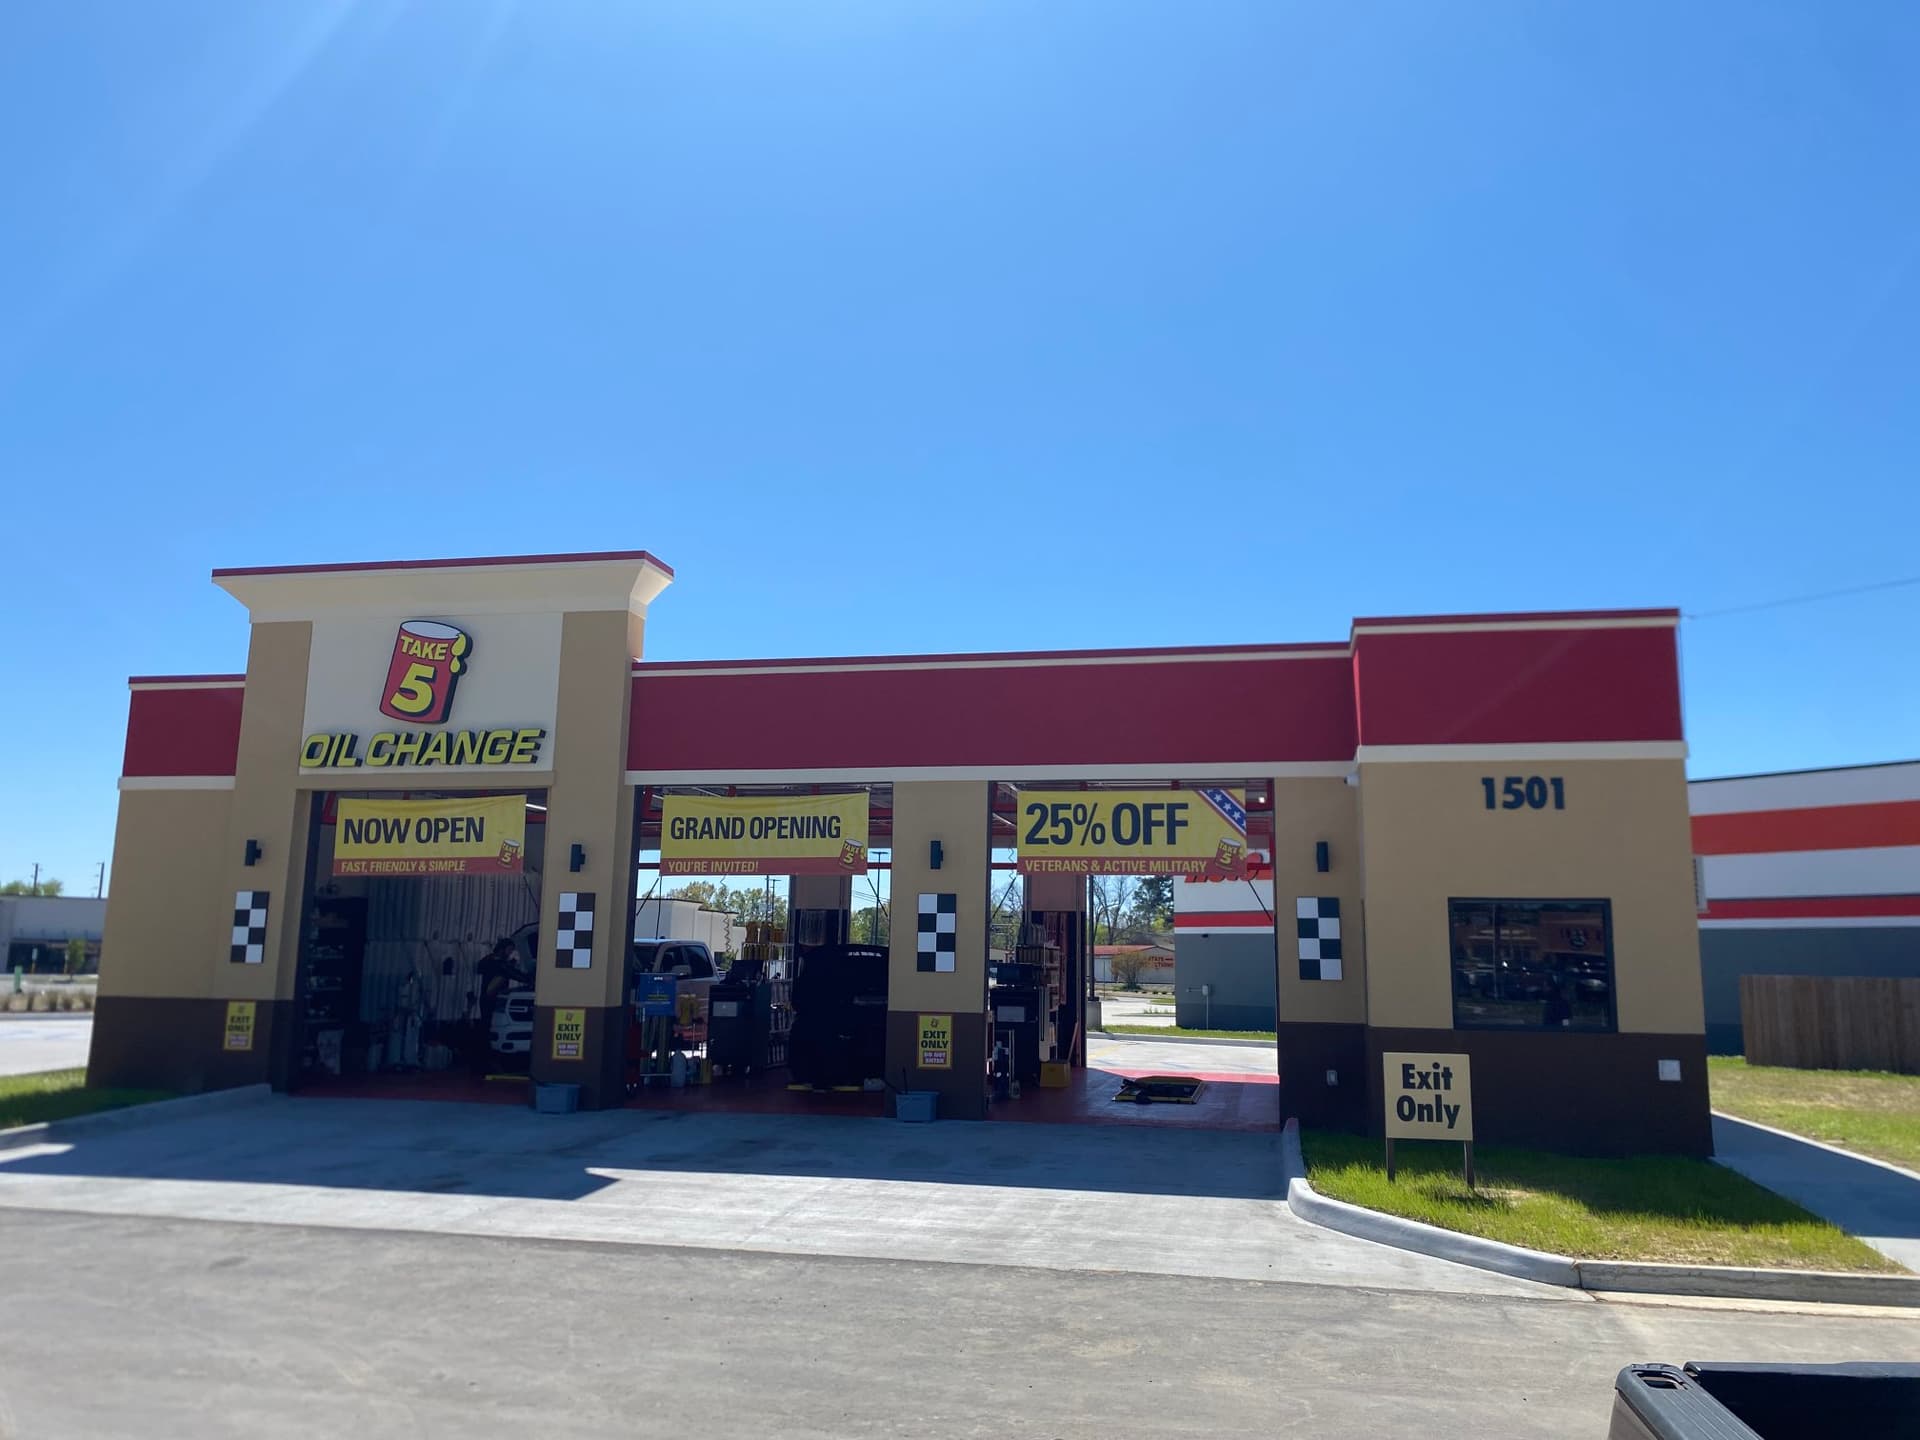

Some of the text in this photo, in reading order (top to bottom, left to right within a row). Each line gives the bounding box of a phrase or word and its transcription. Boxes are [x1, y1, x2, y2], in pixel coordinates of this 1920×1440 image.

[400, 634, 449, 661] TAKE
[390, 662, 437, 716] 5
[299, 728, 546, 768] OIL CHANGE
[1481, 775, 1566, 811] 1501
[343, 816, 485, 845] NOW OPEN
[670, 815, 841, 840] GRAND OPENING
[1024, 802, 1189, 846] 25% OFF
[341, 859, 466, 874] FAST, FRIENDLY & SIMPLE
[501, 852, 512, 864] 5
[668, 860, 759, 873] YOU'RE INVITED!
[843, 852, 854, 864] 5
[1025, 859, 1208, 873] VETERANS & ACTIVE MILITARY
[1219, 852, 1232, 864] 5
[921, 1040, 948, 1048] ONLY
[923, 1031, 946, 1039] EXIT
[1401, 1061, 1453, 1091] Exit
[1396, 1093, 1461, 1130] Only
